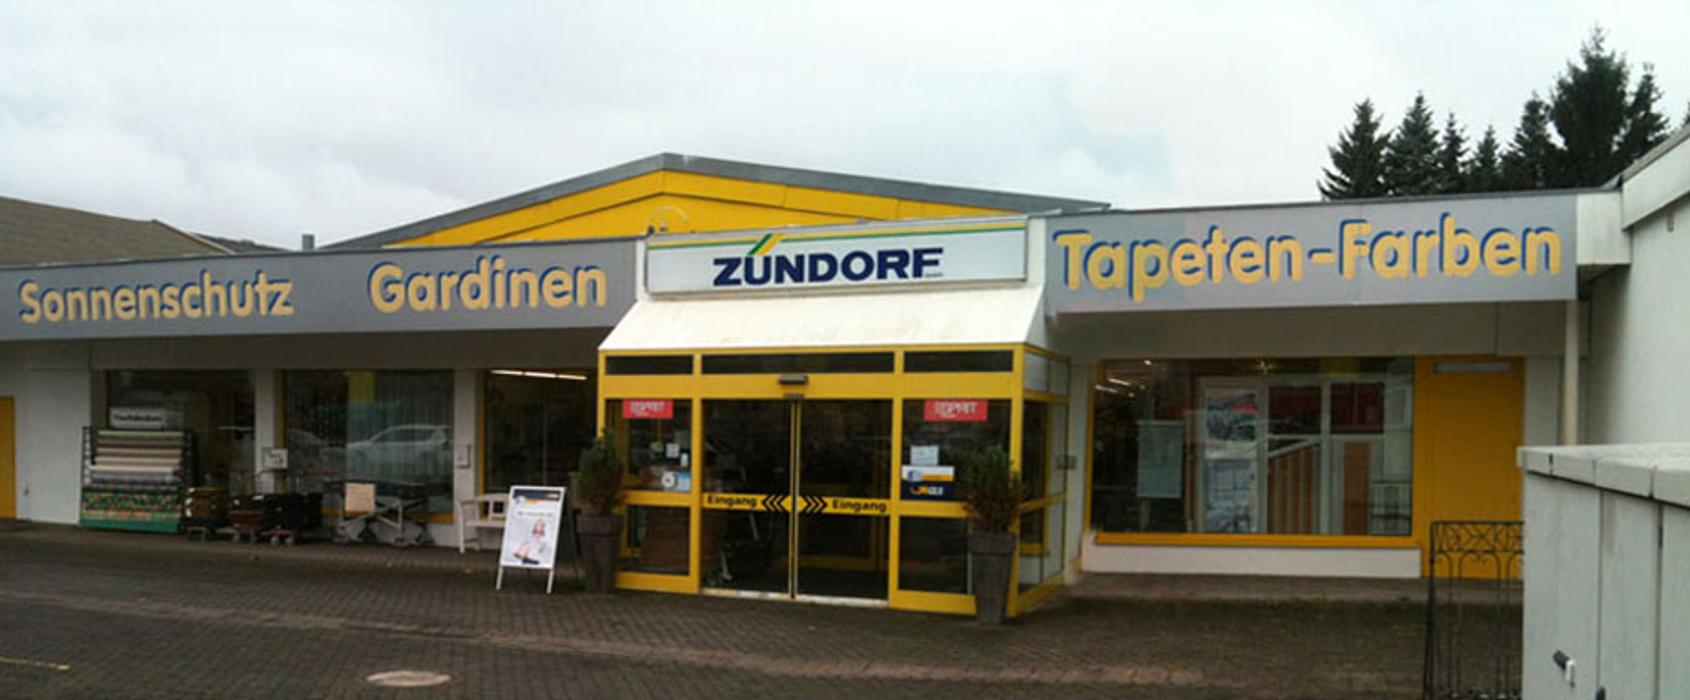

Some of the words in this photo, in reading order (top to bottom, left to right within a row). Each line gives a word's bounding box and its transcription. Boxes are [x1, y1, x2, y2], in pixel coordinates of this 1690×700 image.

[1053, 212, 1562, 303] Tapeten-Farben
[19, 268, 295, 323] Sonnenschutz
[367, 255, 608, 313] Gardinen
[707, 494, 758, 507] Eingang
[833, 499, 887, 513] Eingang
